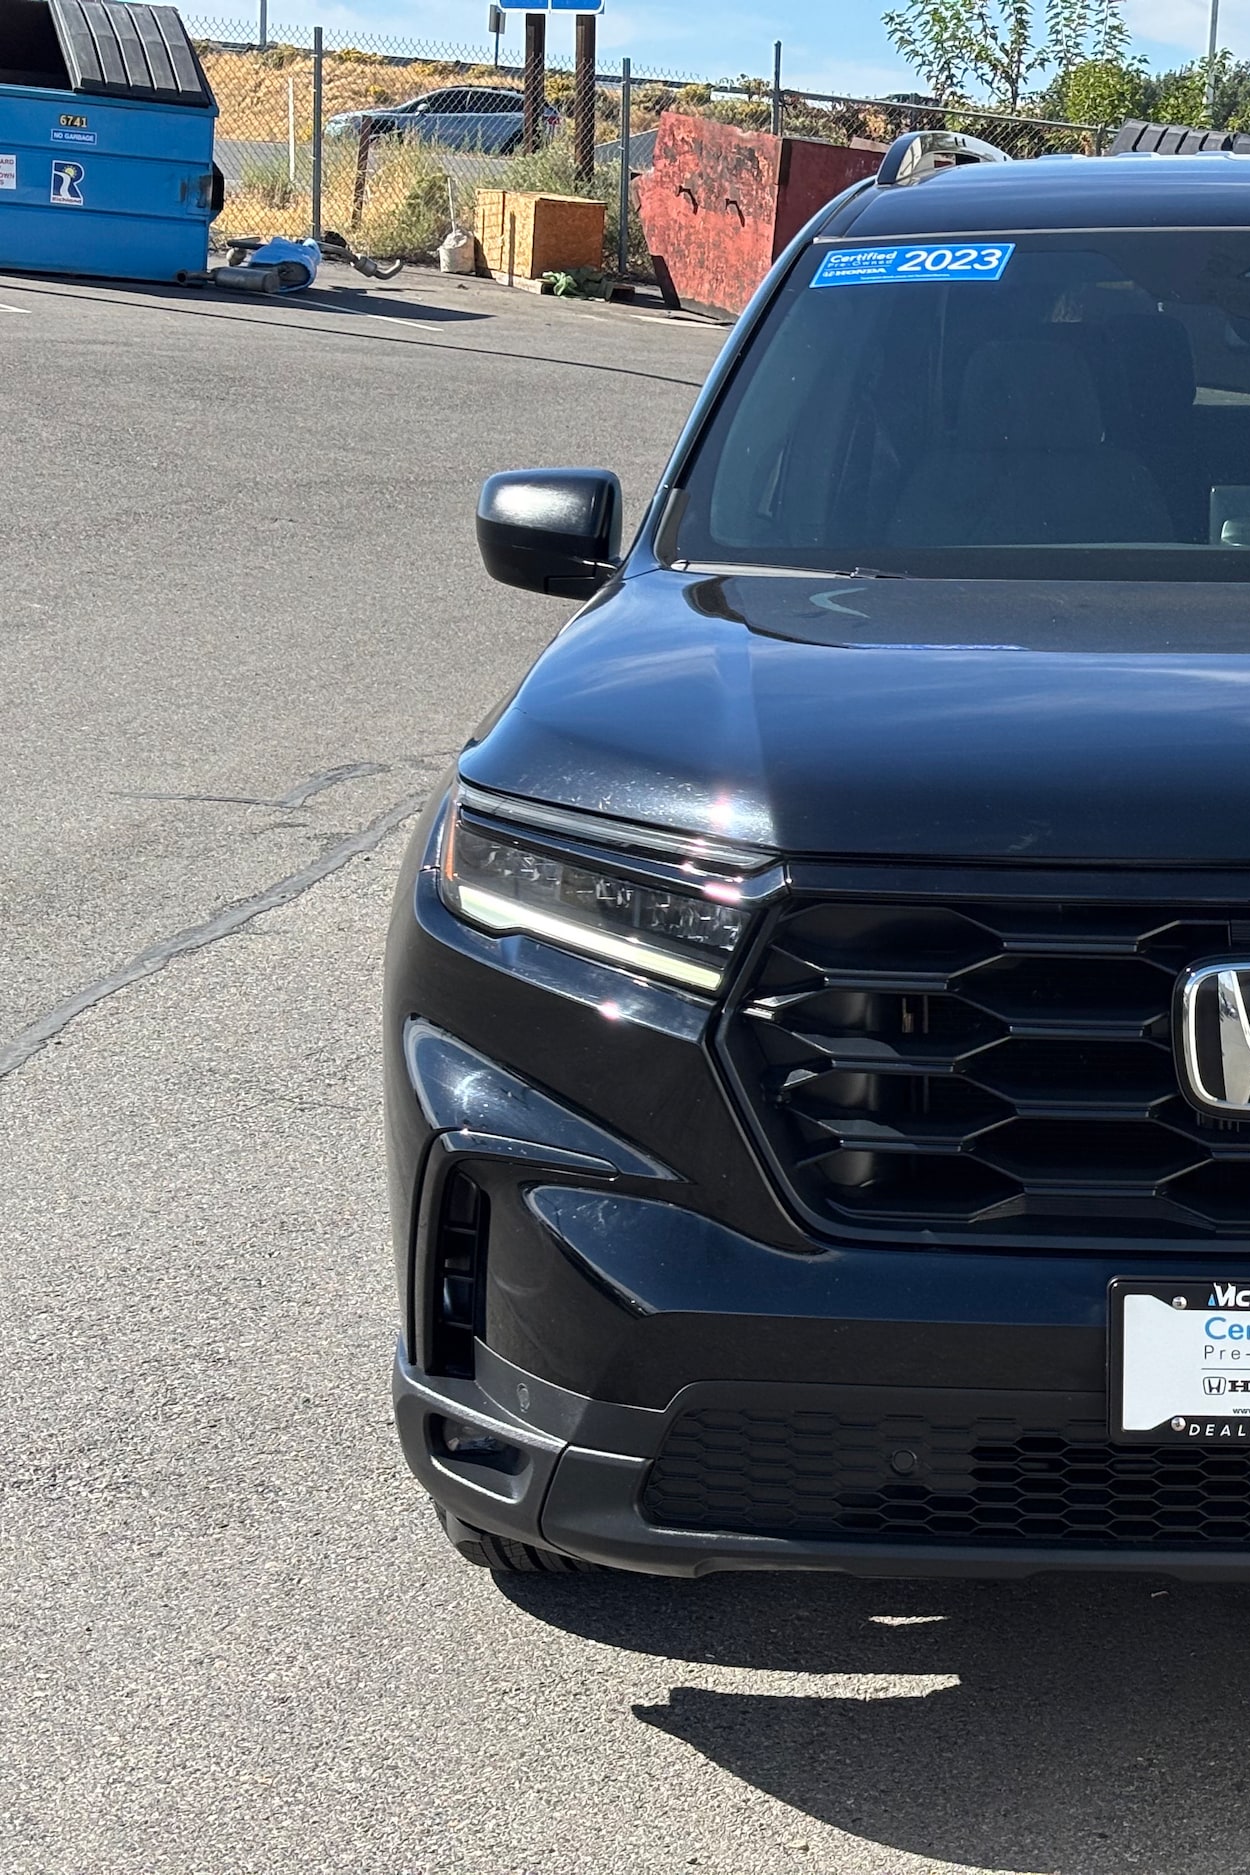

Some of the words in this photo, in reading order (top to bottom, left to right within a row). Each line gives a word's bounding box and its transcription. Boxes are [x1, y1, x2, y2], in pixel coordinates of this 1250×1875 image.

[60, 115, 88, 128] 6741
[64, 133, 94, 142] GARBAGE
[830, 251, 898, 263] Certified
[897, 248, 1003, 272] 2023
